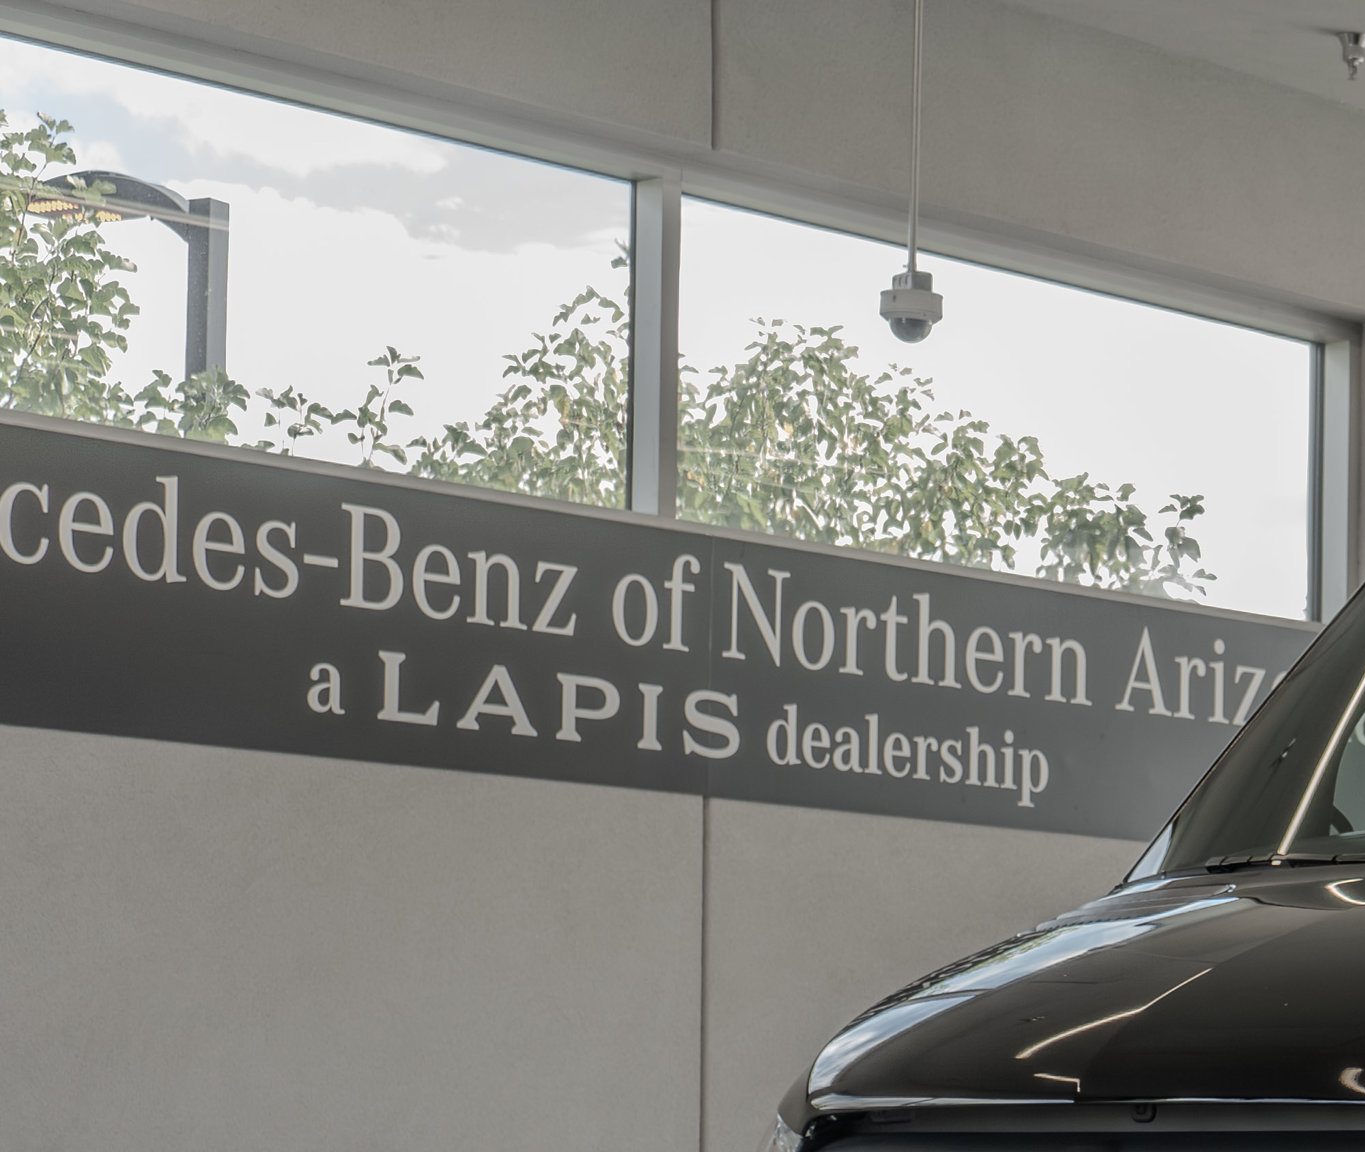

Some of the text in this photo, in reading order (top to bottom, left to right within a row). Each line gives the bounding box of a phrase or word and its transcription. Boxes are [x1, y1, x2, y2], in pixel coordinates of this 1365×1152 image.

[0, 475, 578, 637] cedes-Benz
[612, 554, 701, 653] of
[722, 562, 1094, 706] Northern
[307, 650, 1050, 808] a LAPIS dealership
